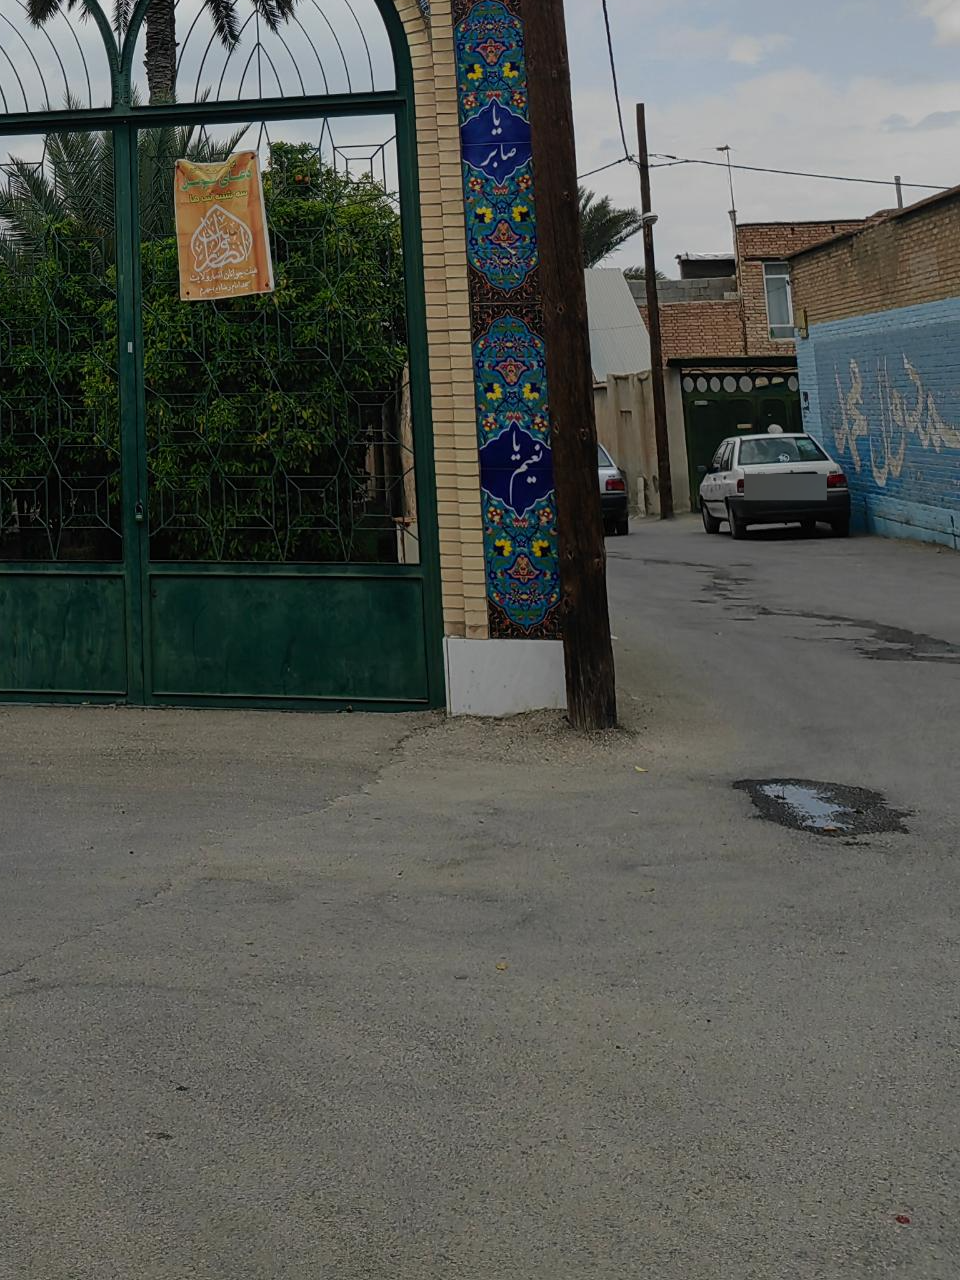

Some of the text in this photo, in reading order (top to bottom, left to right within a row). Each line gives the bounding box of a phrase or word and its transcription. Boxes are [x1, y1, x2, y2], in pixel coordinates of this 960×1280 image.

[491, 104, 503, 136] یا
[480, 143, 517, 168] صابر
[510, 429, 521, 461] یا
[509, 443, 543, 506] نعیم
